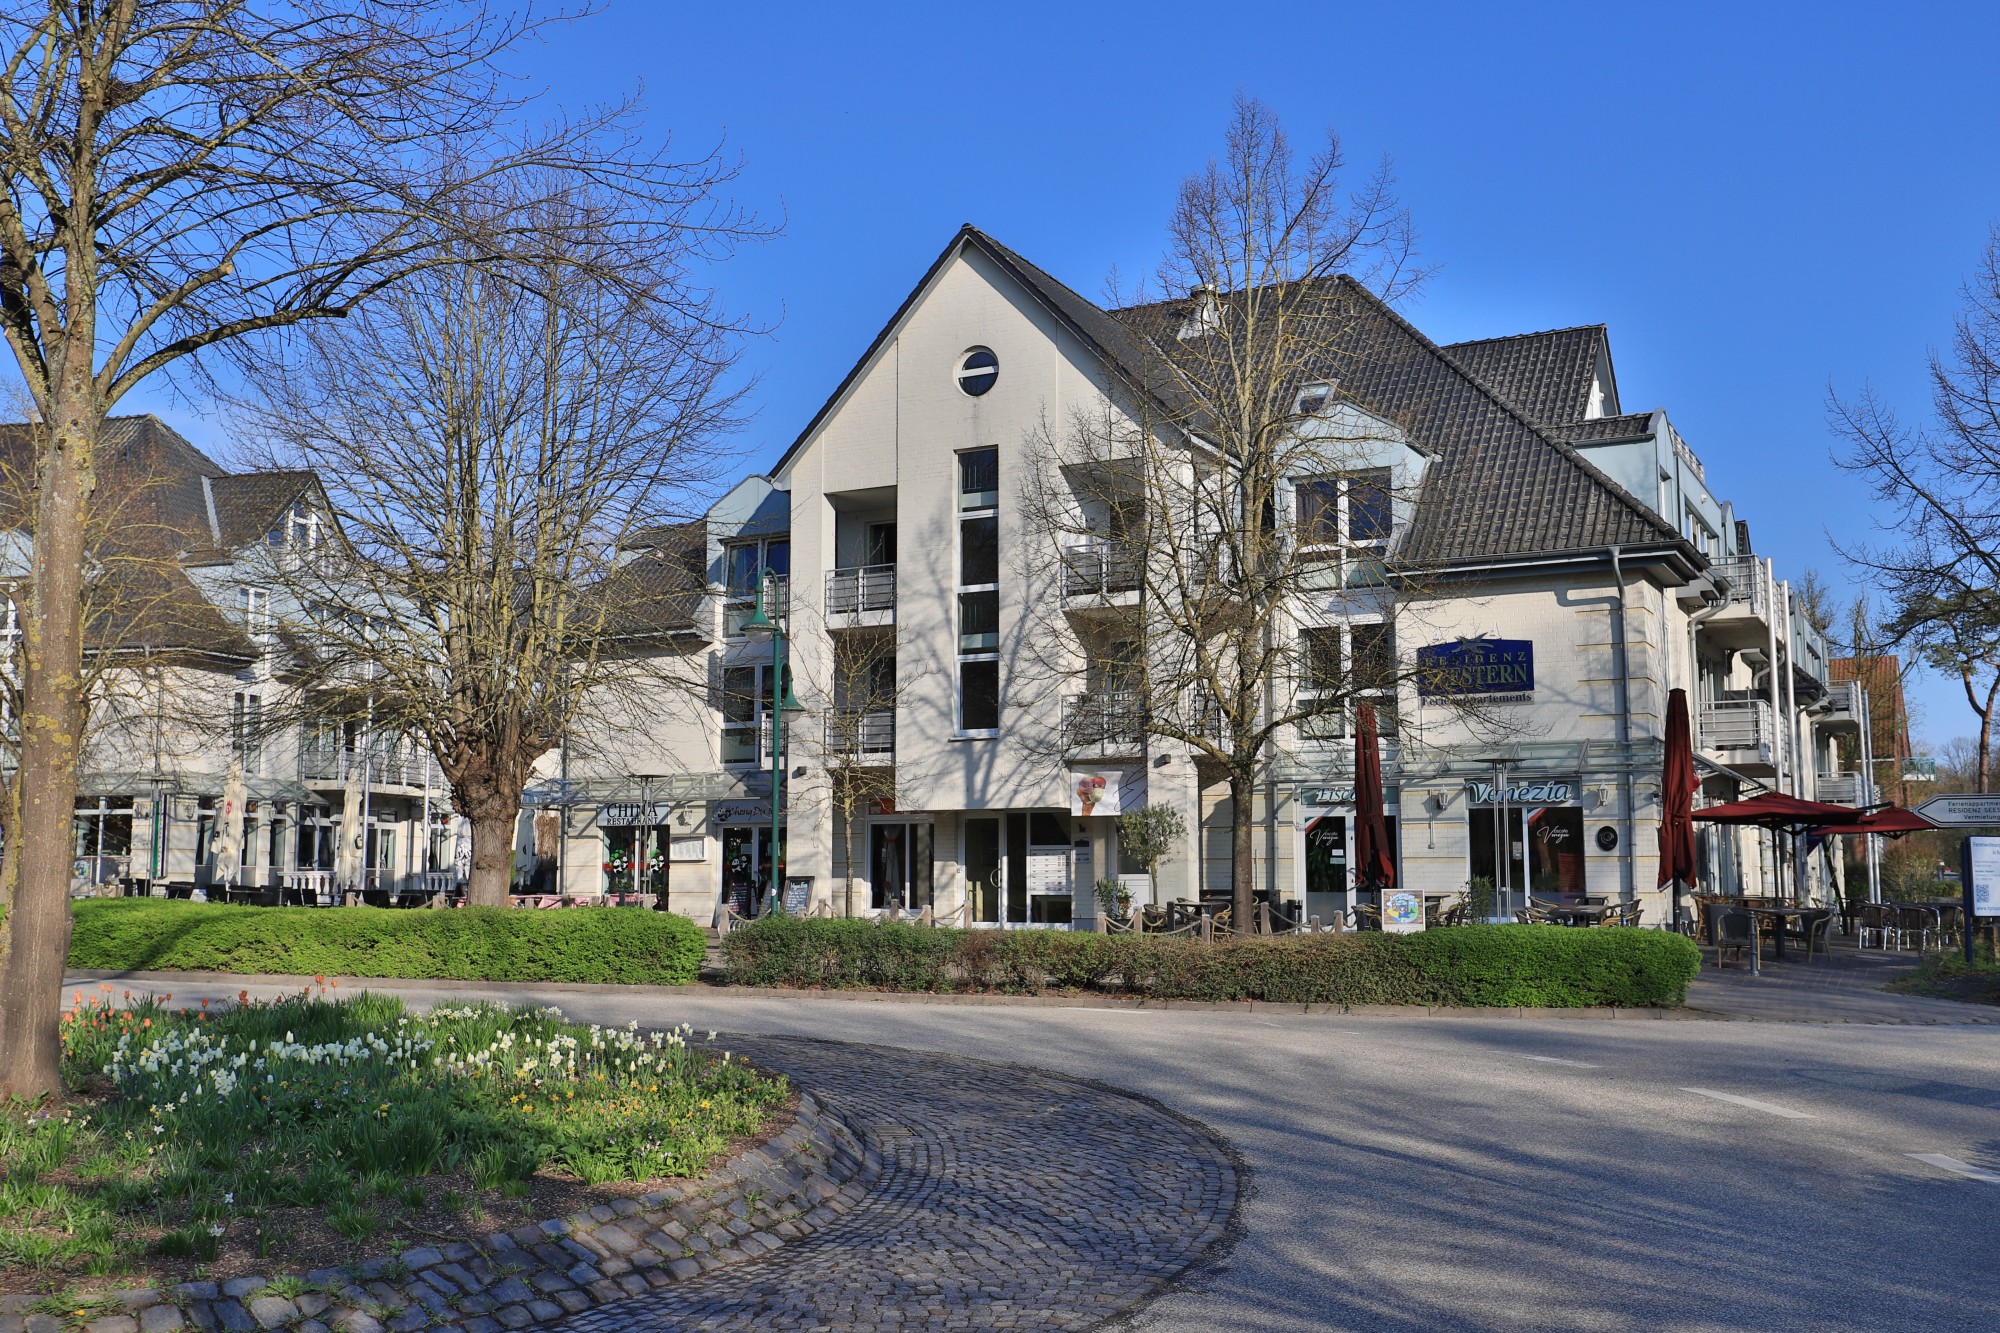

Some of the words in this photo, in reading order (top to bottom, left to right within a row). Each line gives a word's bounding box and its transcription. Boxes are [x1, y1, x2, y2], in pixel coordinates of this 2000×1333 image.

[1466, 781, 1571, 803] Venezia
[606, 802, 659, 818] CHINA
[606, 817, 659, 826] RESTAURANT
